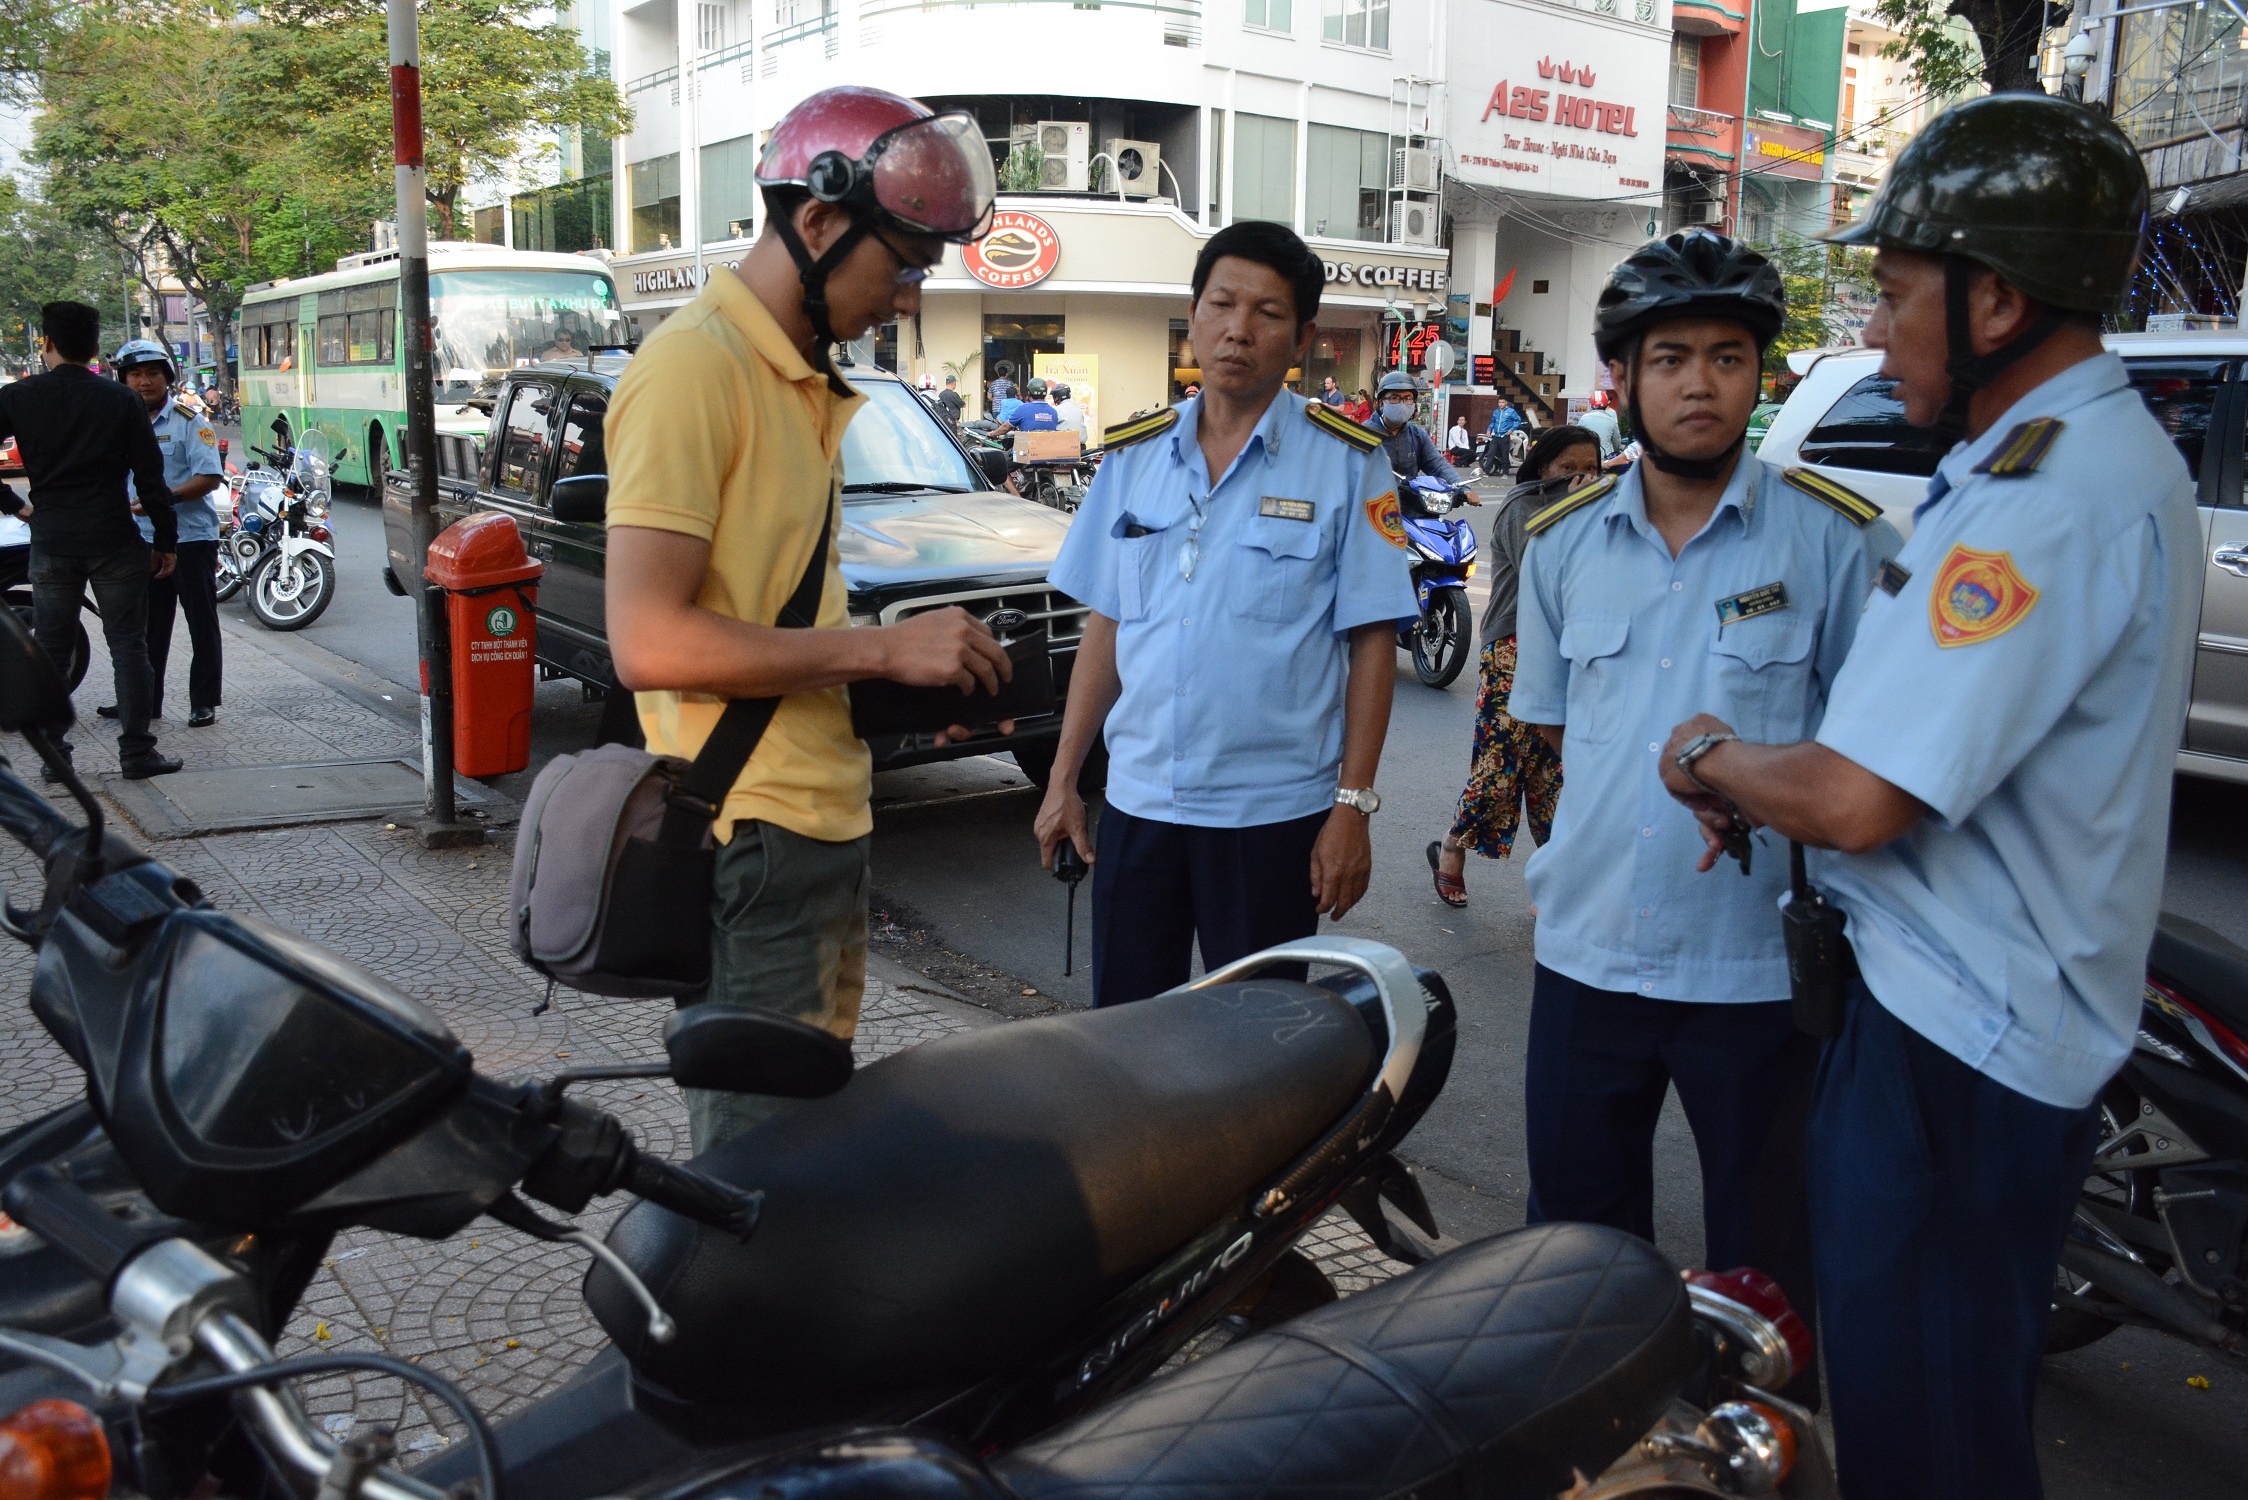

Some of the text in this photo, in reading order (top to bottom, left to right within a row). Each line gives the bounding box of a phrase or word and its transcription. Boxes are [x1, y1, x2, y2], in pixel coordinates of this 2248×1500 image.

[1481, 79, 1550, 122] A25
[1503, 133, 1520, 150] Your
[1523, 137, 1544, 153] House
[972, 216, 1053, 247] HLANDS
[633, 263, 714, 292] HIGHLAN
[978, 265, 1044, 284] COFFEE
[1358, 264, 1446, 289] COFFEE
[1392, 325, 1440, 348] A25
[997, 615, 1017, 625] Ford
